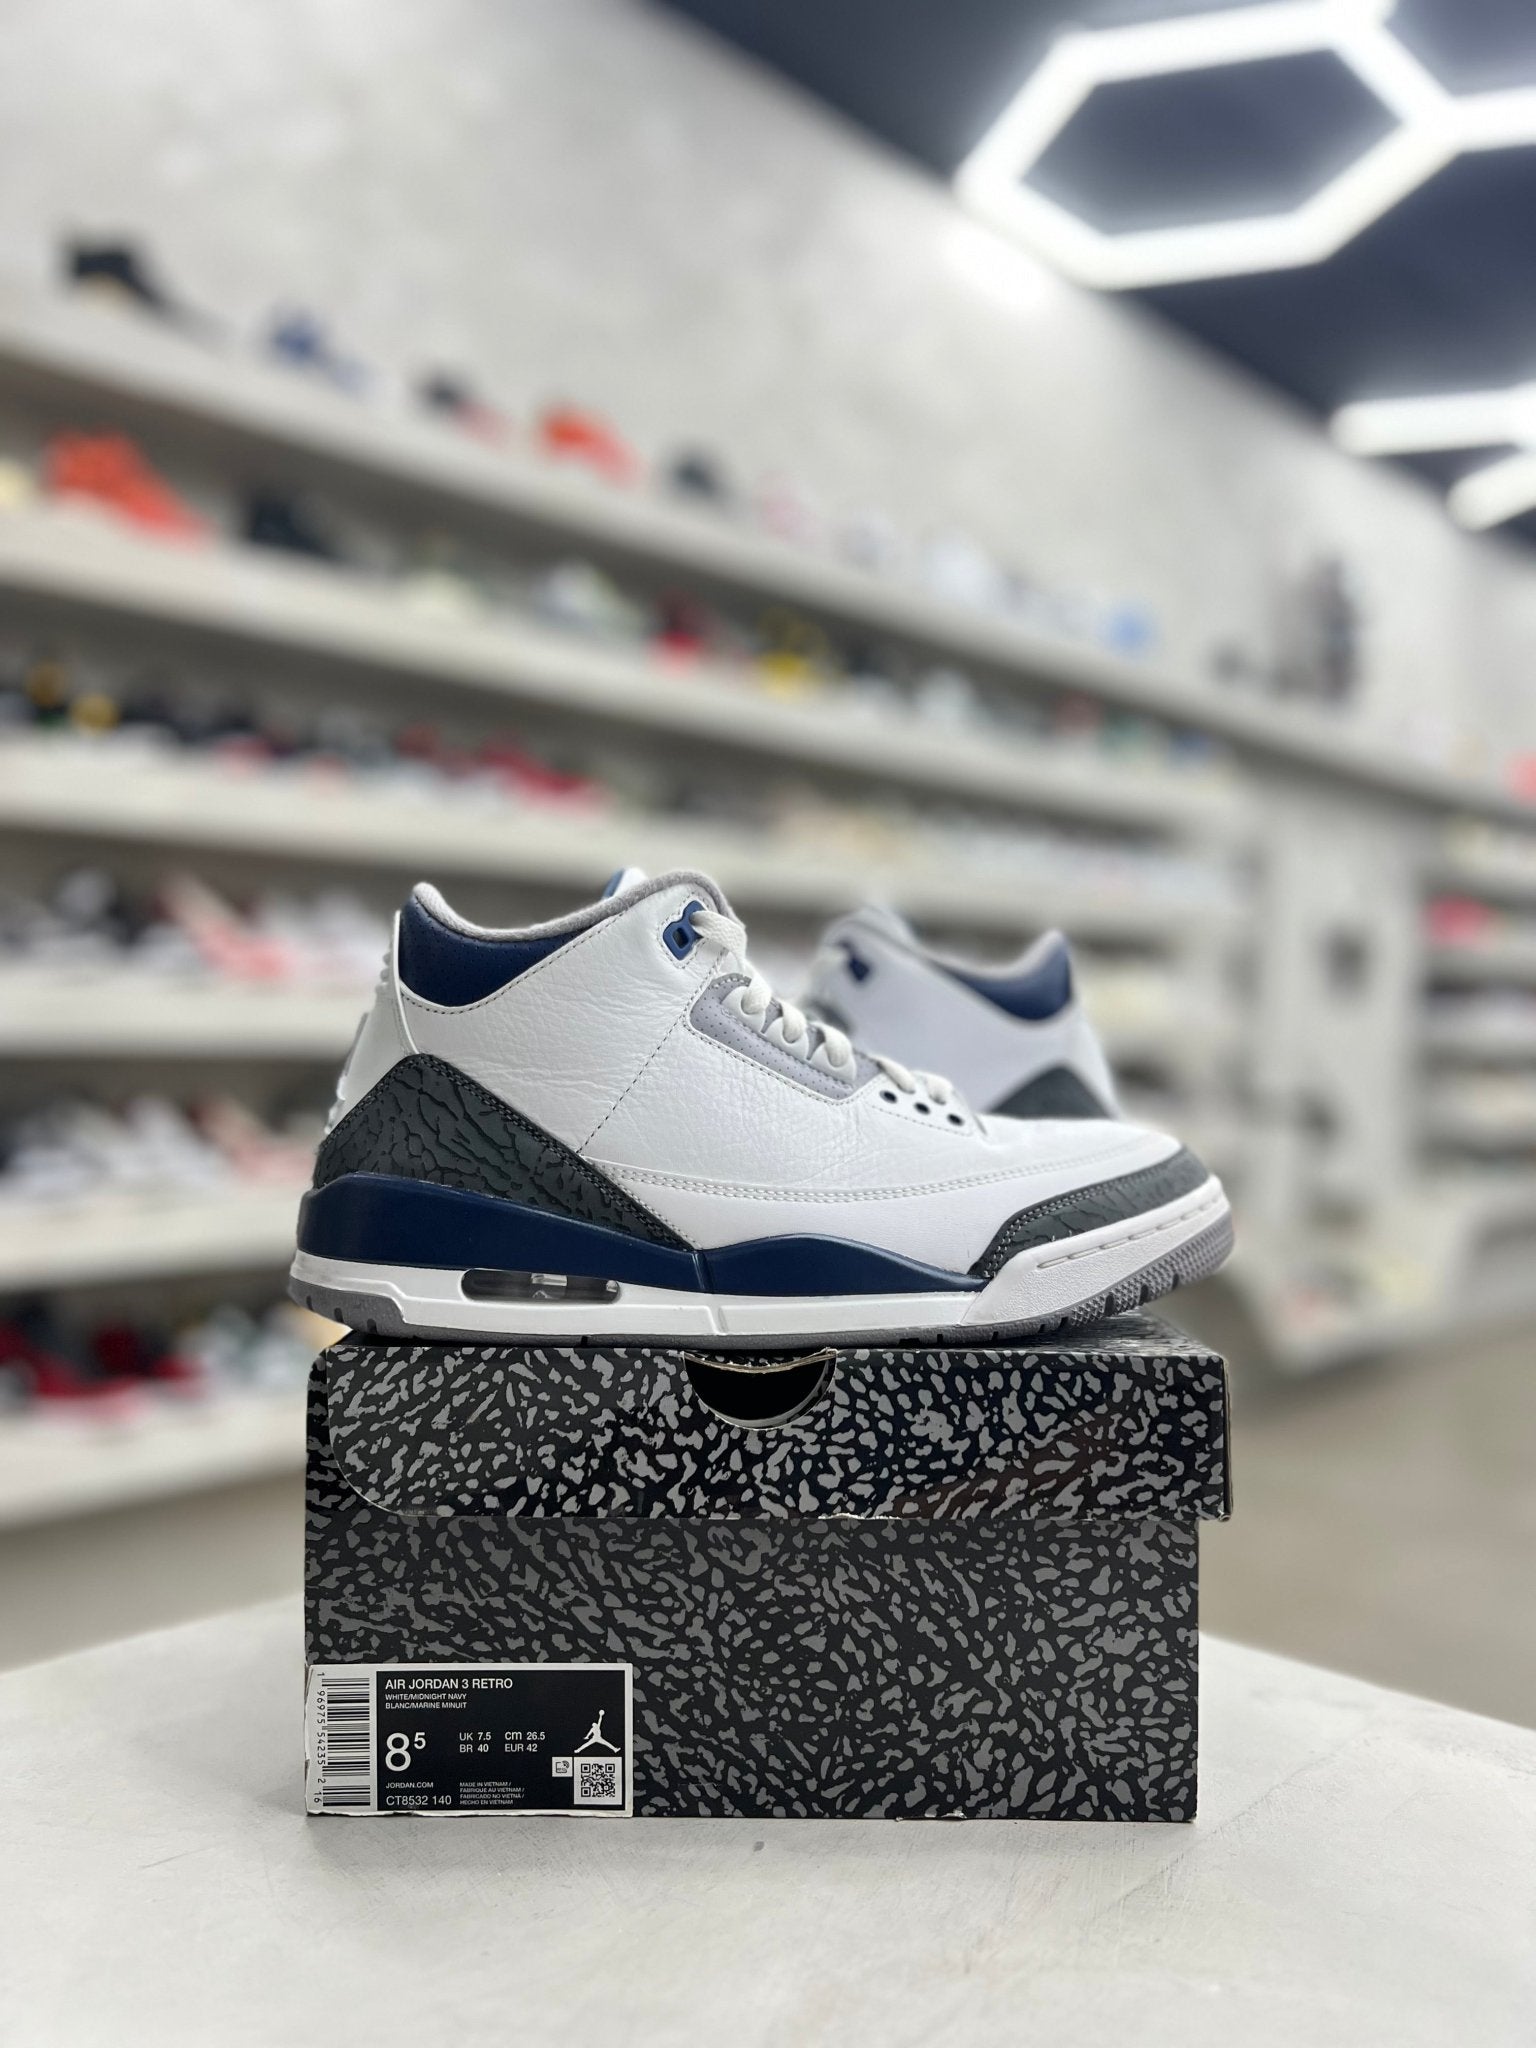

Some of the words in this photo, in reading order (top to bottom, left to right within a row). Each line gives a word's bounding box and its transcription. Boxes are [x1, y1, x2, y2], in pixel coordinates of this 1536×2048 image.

[385, 1679, 406, 1690] AIR
[408, 1679, 459, 1690] JORDAN
[461, 1679, 469, 1689] 3
[472, 1678, 513, 1689] RETRO
[317, 1690, 325, 1724] 96975
[459, 1732, 473, 1741] UK
[477, 1732, 492, 1740] 7.5
[504, 1731, 523, 1740] cm
[526, 1731, 546, 1740] 26.5
[317, 1732, 325, 1765] 54235
[459, 1744, 473, 1752] BR
[477, 1744, 489, 1752] 40
[504, 1743, 524, 1752] EUR
[526, 1743, 538, 1752] 42
[313, 1791, 322, 1803] 16
[386, 1795, 429, 1806] CT8532
[432, 1795, 452, 1805] 140
